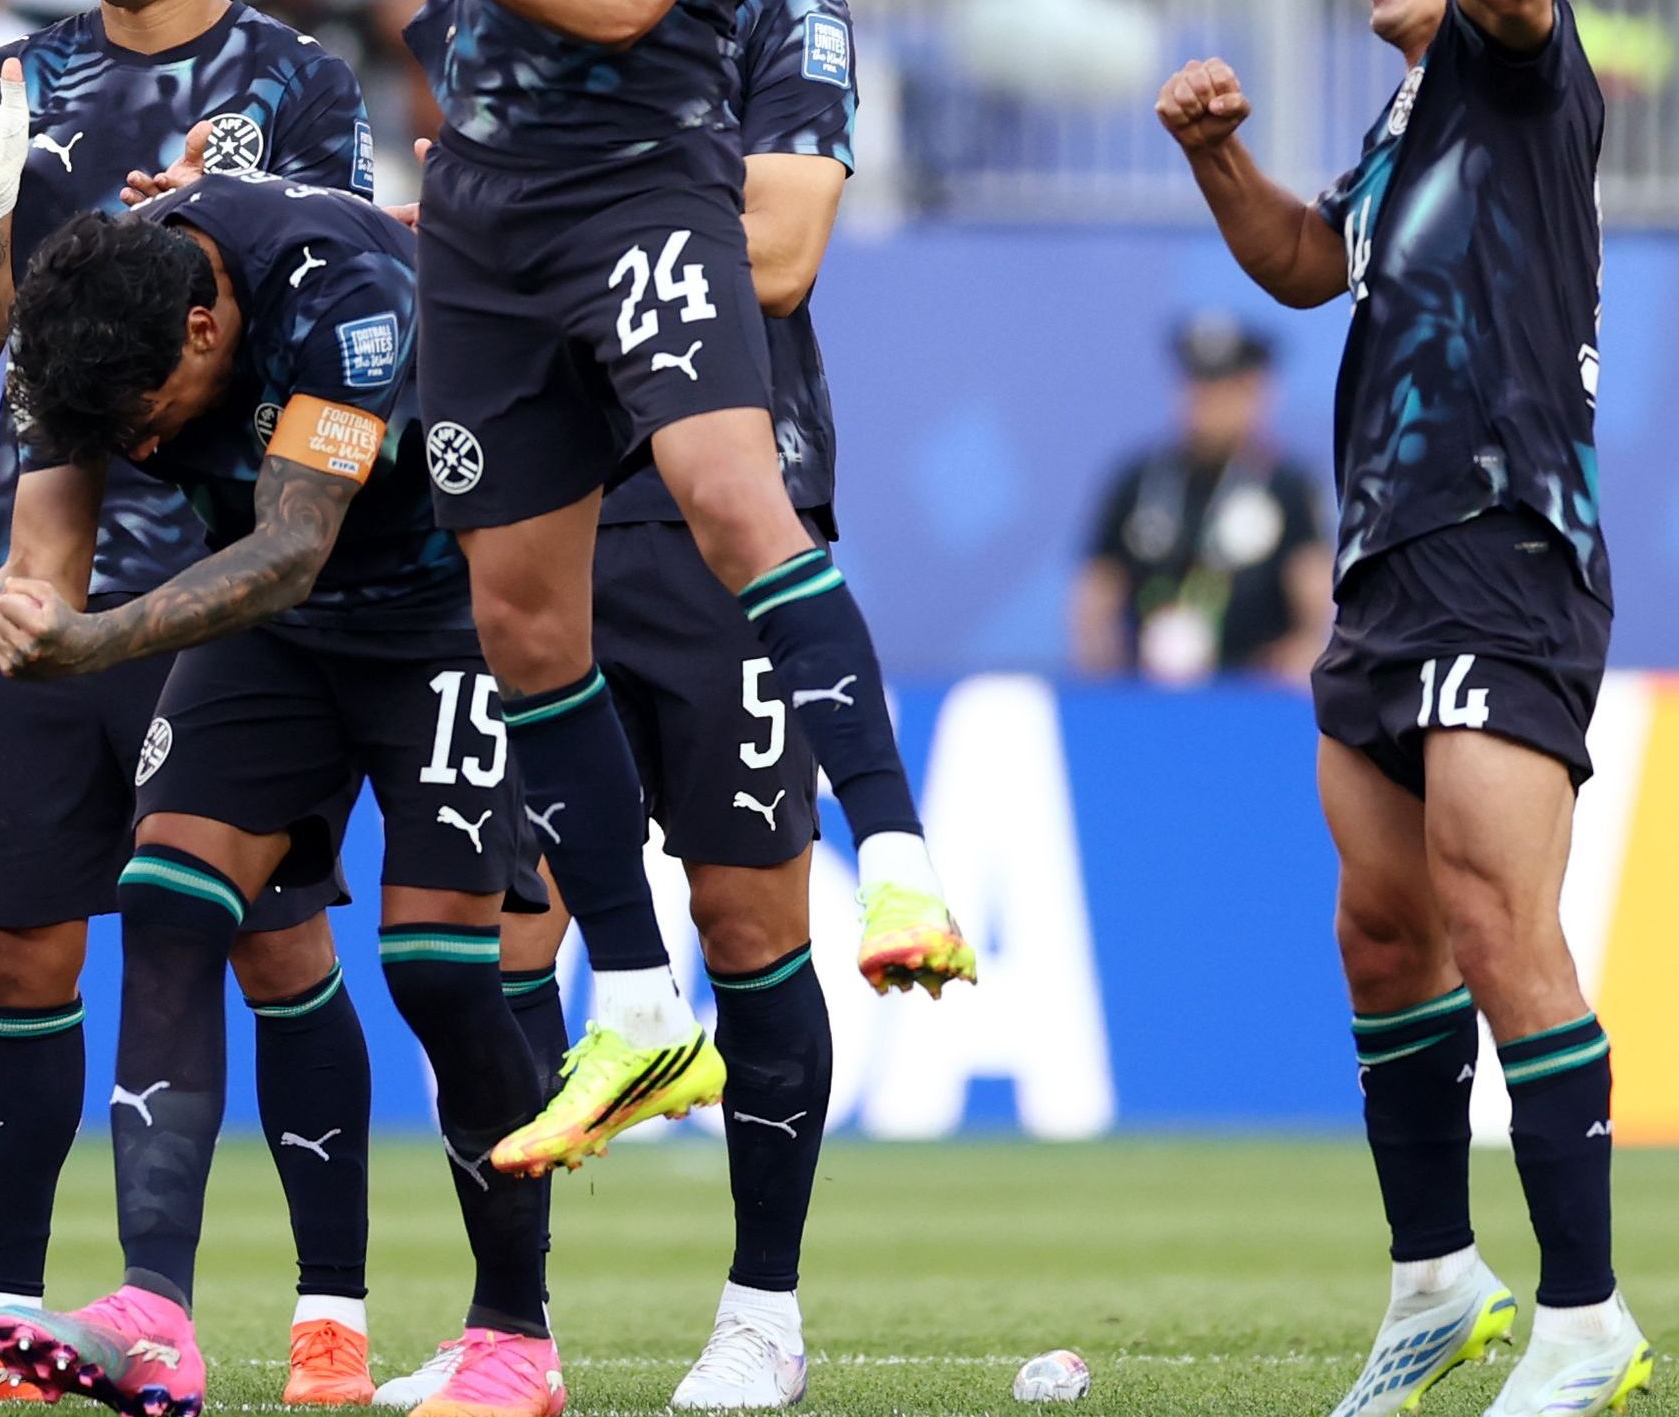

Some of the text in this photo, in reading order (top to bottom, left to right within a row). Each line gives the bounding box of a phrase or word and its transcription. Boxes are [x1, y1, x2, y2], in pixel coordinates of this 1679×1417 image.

[219, 118, 244, 130] APF
[609, 231, 716, 354] 24
[353, 336, 393, 355] UNITES
[316, 418, 378, 452] UNITES
[321, 406, 378, 435] FOOTBALL
[308, 434, 337, 455] the
[331, 460, 357, 472] FIFA
[1417, 654, 1490, 728] 14
[740, 658, 786, 769] 5
[420, 672, 508, 788] 15
